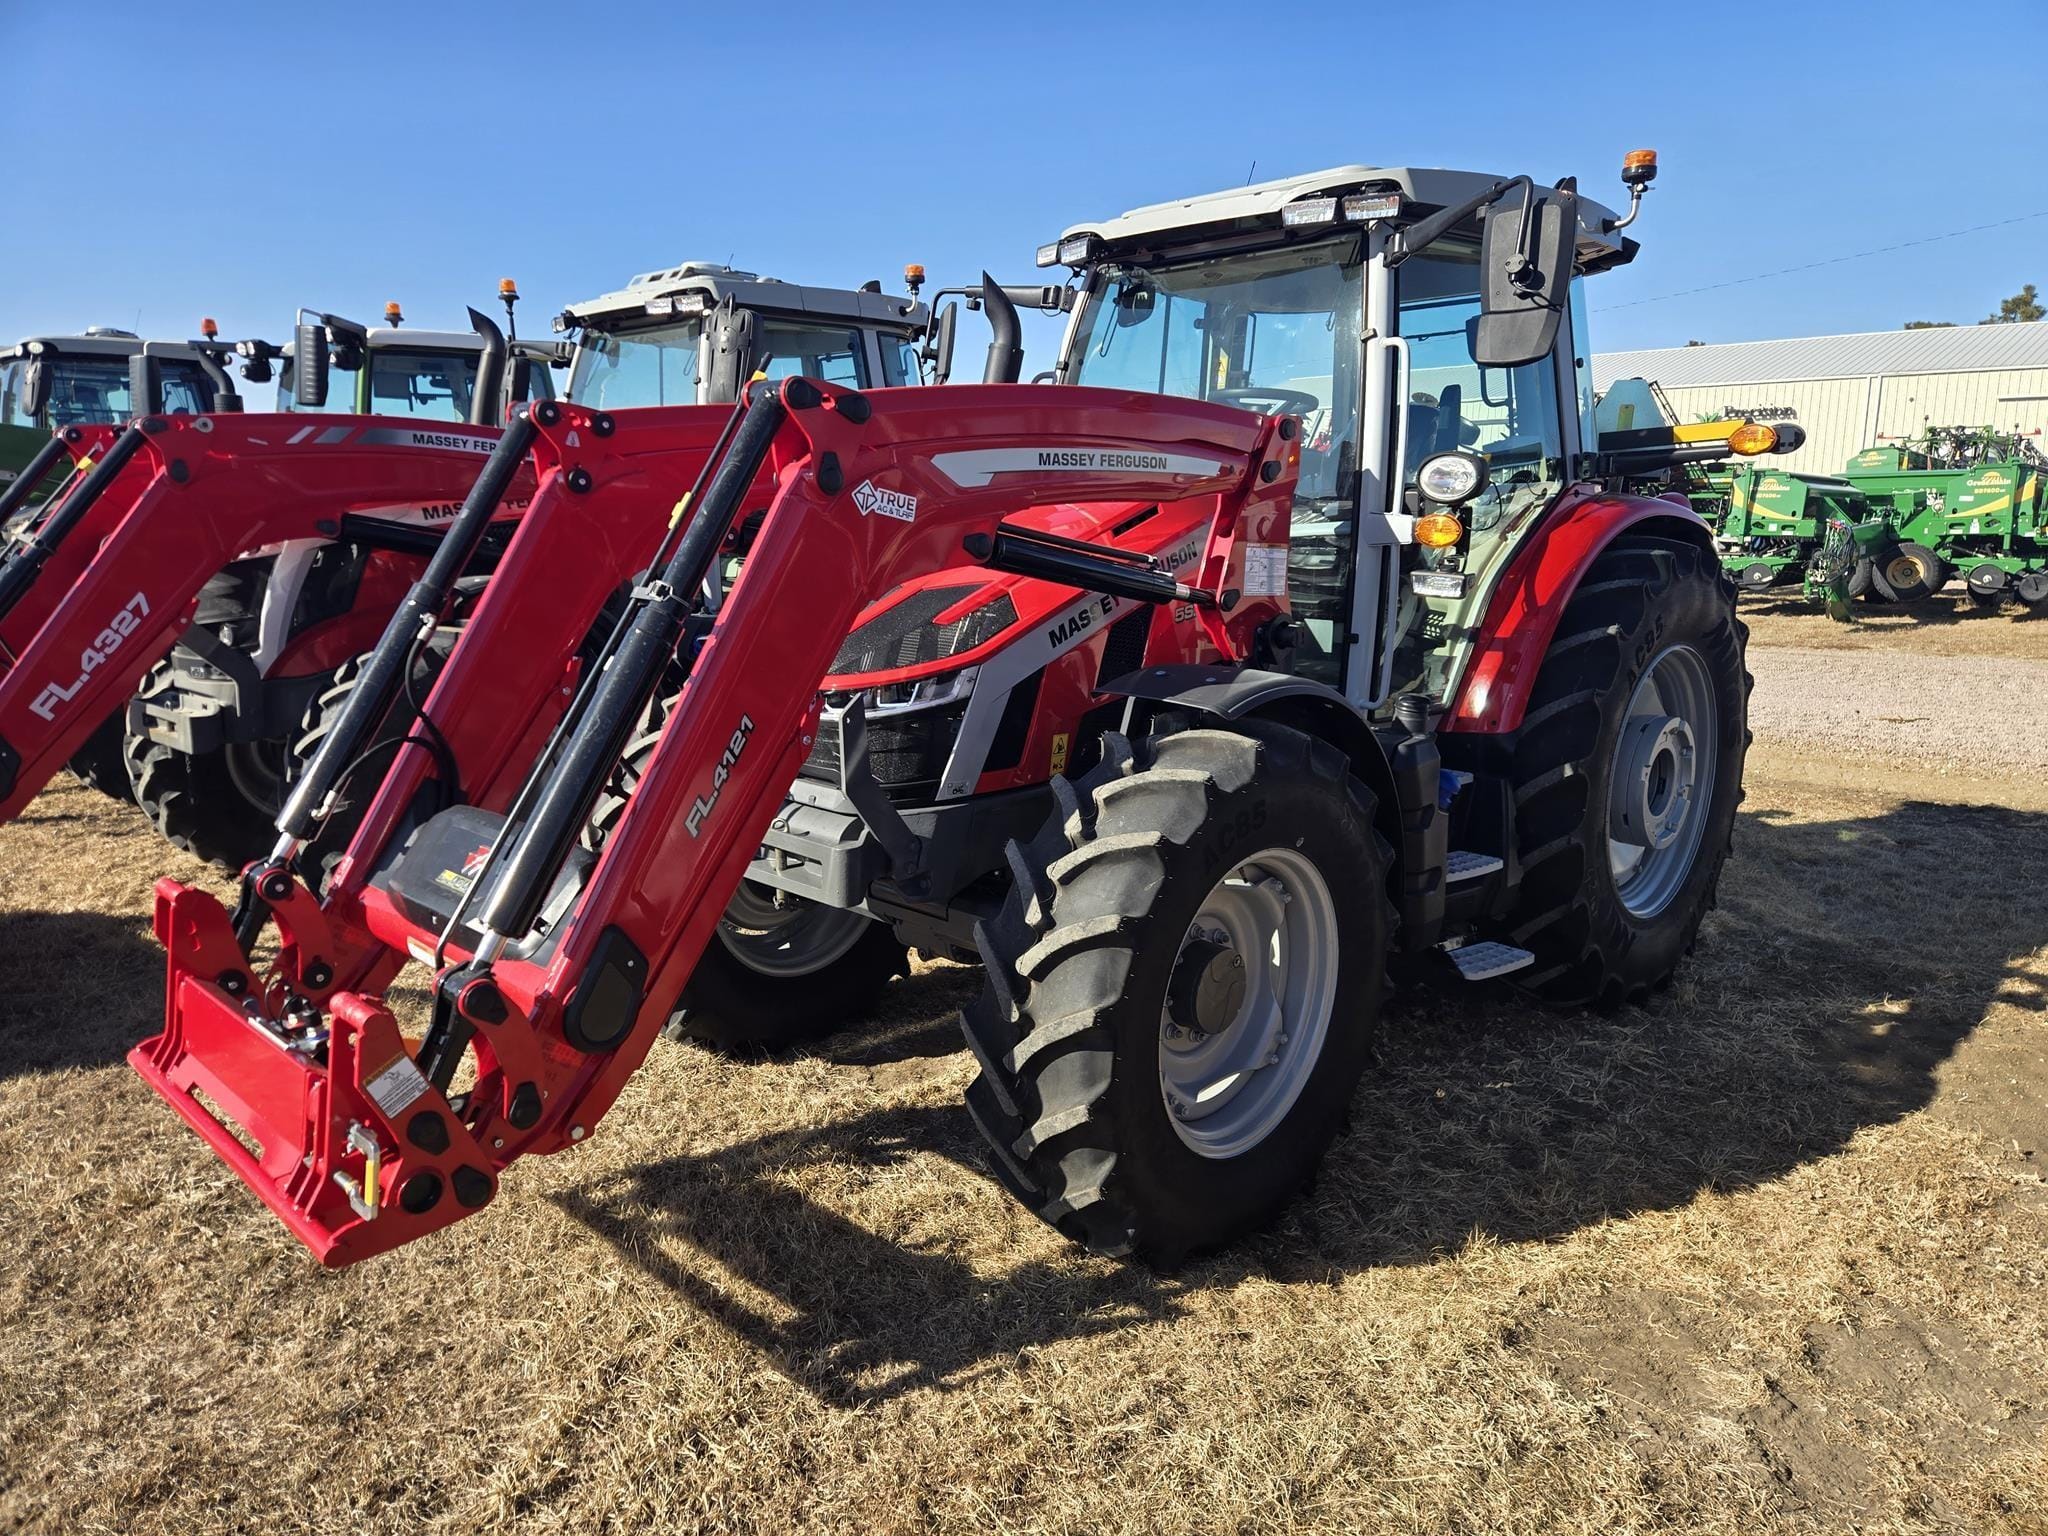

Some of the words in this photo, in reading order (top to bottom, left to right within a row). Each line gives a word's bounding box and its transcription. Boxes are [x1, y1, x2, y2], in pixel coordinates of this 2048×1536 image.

[1724, 403, 1798, 420] Precision
[412, 433, 469, 449] MASSEY
[1038, 453, 1096, 466] MASSEY
[1100, 454, 1168, 469] FERGUSON
[879, 490, 915, 511] TRUE
[28, 591, 150, 722] FL.4327
[684, 714, 754, 838] FL.4121
